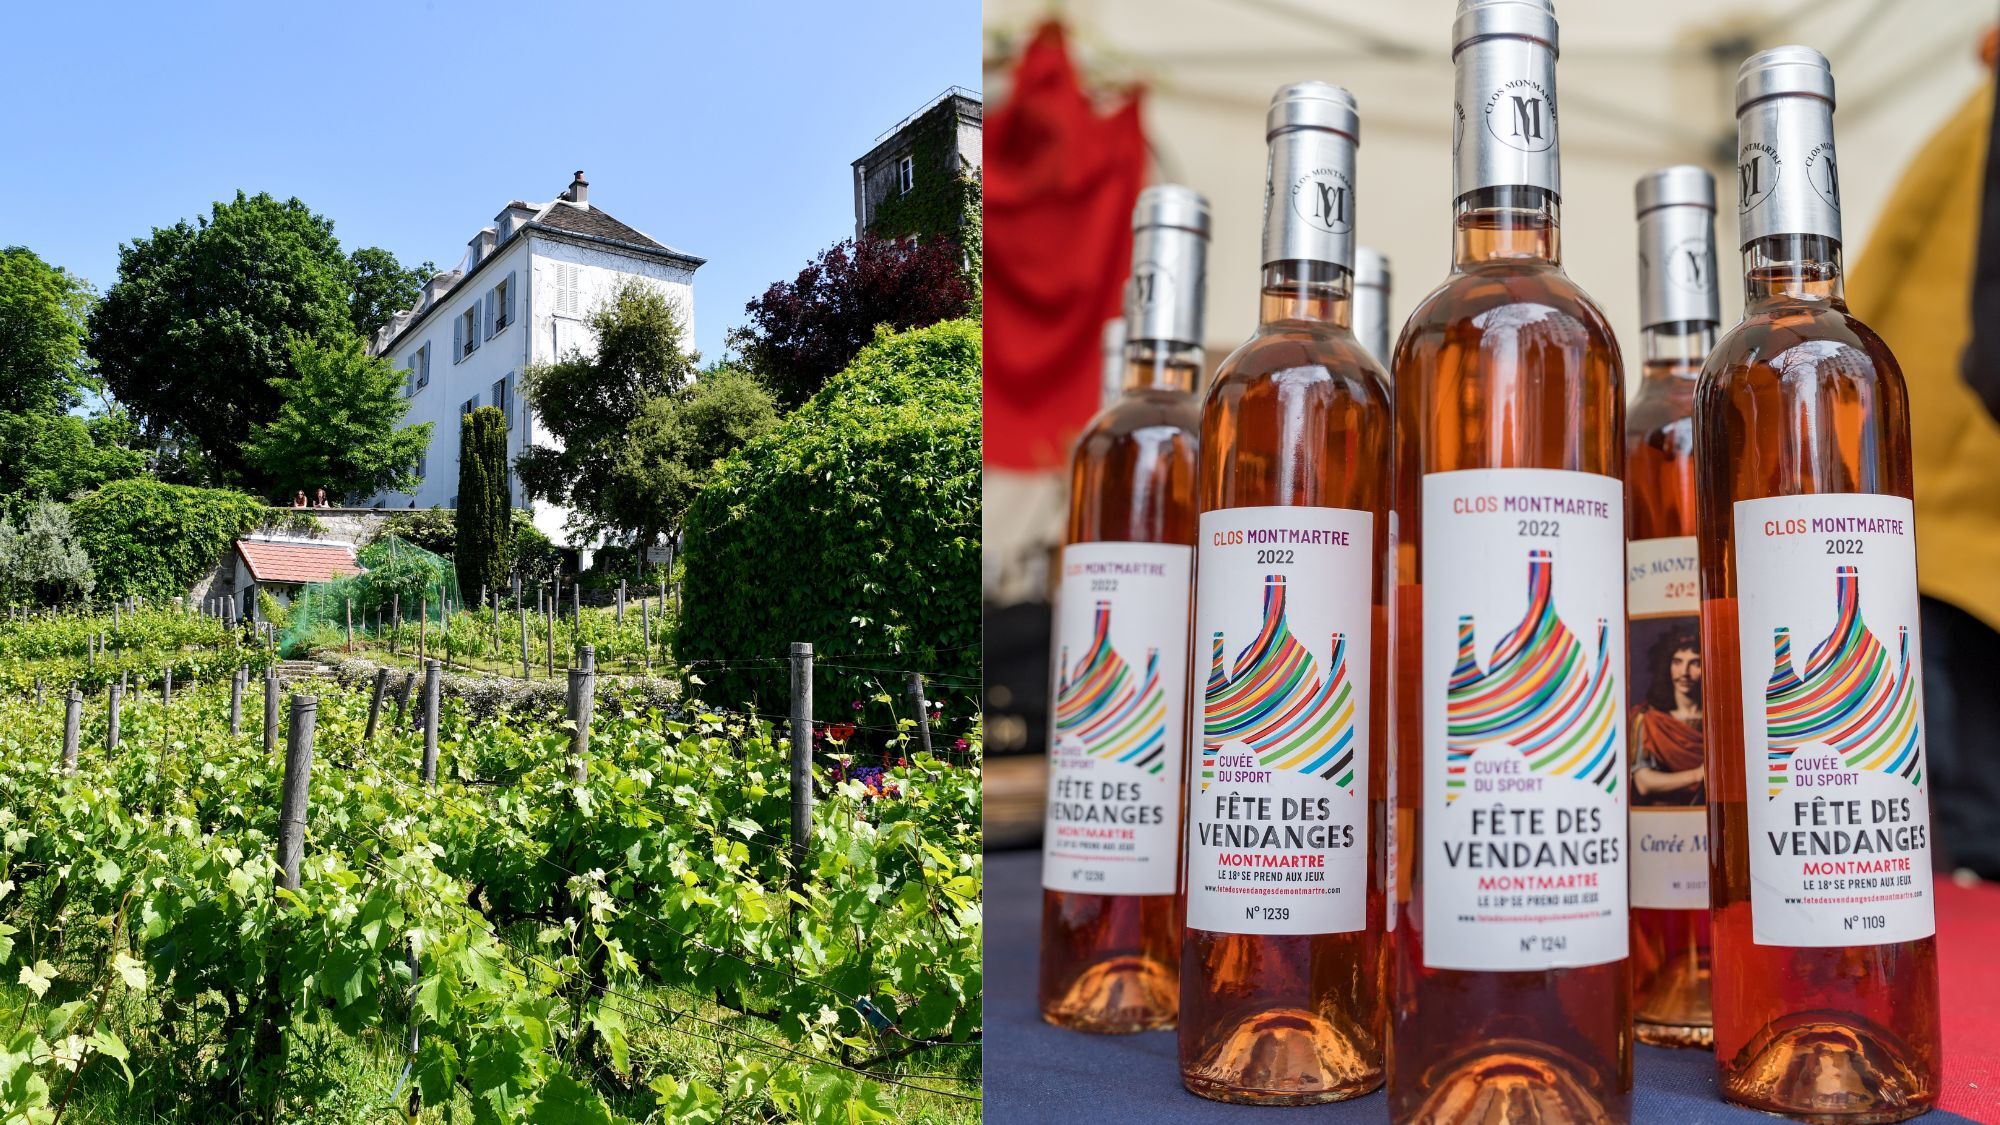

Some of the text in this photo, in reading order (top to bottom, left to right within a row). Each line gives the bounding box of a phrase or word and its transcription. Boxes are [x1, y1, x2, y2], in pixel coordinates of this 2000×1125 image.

[1485, 87, 1504, 114] CLOS
[1805, 146, 1821, 168] CLOS
[1453, 496, 1609, 518] CLOS MONTMARTRE
[1518, 520, 1560, 537] 2022
[1764, 517, 1904, 536] CLOS MONTMARTRE
[1213, 529, 1350, 546] CLOS MONTMARTRE
[1826, 539, 1864, 554] 2022
[1257, 549, 1294, 564] 2022
[1650, 557, 1697, 573] MONT
[1665, 582, 1697, 598] 202
[1219, 753, 1253, 768] CUVÉE
[1474, 760, 1520, 774] CUVÉE
[1795, 755, 1838, 771] CUVÉE
[1219, 771, 1272, 783] DU SPORT
[1474, 778, 1543, 792] DU SPORT
[1796, 773, 1859, 787] DU SPORT
[1102, 781, 1141, 801] DES
[1216, 791, 1331, 821] FÊTE DES
[1794, 796, 1911, 826] FÊTE DES
[1472, 803, 1601, 835] FÊTE DES
[1199, 822, 1355, 849] VENDANGES
[1640, 833, 1685, 853] Cuvée
[1767, 824, 1926, 856] VENDANGES
[1218, 853, 1325, 868] MONTMARTRE
[1444, 838, 1619, 868] VENDANGES
[1803, 857, 1911, 875] MONTMARTRE
[1218, 870, 1226, 880] LE
[1242, 871, 1251, 881] SE
[1254, 871, 1283, 882] PREND
[1285, 872, 1303, 882] AUX
[1304, 871, 1325, 882] JEUX
[1478, 873, 1599, 890] MONTMARTRE
[1803, 880, 1814, 890] LE
[1834, 879, 1845, 889] SE
[1848, 877, 1878, 889] PREND
[1880, 877, 1894, 887] AUX
[1896, 875, 1912, 886] JEUX
[1263, 907, 1290, 920] 1239
[1862, 915, 1885, 929] 1109
[1541, 936, 1567, 951] 1241
